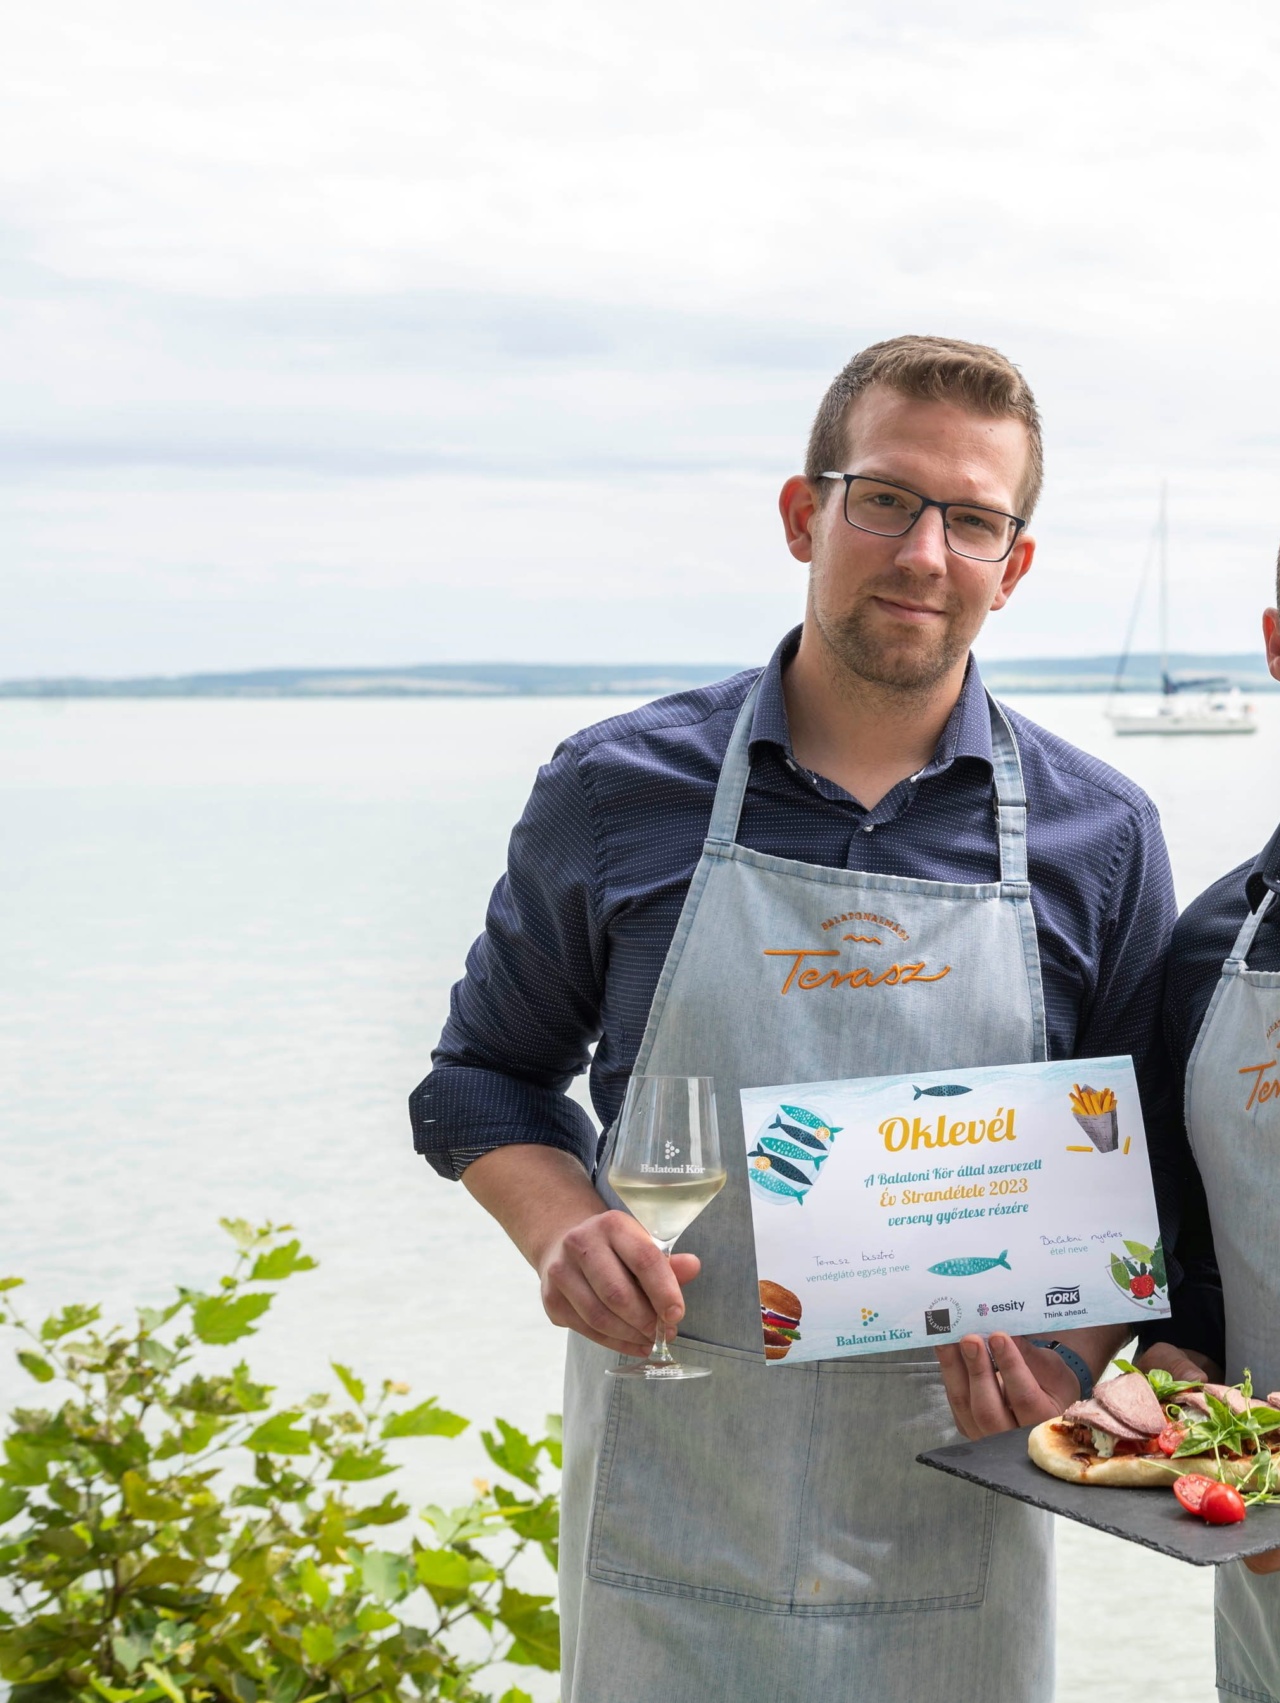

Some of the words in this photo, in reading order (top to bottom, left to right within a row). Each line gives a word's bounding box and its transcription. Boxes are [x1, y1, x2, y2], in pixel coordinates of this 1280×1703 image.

[763, 949, 951, 995] Terasz
[878, 1107, 1017, 1152] Oklevél
[640, 1163, 685, 1173] Balatoni
[685, 1164, 705, 1174] Kör
[864, 1174, 875, 1188] A
[877, 1170, 930, 1186] Balatoni
[932, 1167, 954, 1180] Kör
[957, 1164, 985, 1178] által
[987, 1159, 1042, 1175] szervezett
[880, 1187, 897, 1207] Év
[901, 1184, 986, 1205] Strandétele
[989, 1178, 1029, 1196] 2023
[888, 1213, 933, 1227] verseny
[936, 1207, 986, 1225] győztese
[988, 1201, 1029, 1216] részére
[1050, 1246, 1066, 1256] étel
[1068, 1245, 1088, 1254] neve
[806, 1269, 855, 1283] vendéglátó
[857, 1264, 888, 1278] egység
[889, 1264, 910, 1274] neve
[991, 1299, 1025, 1314] essity
[1046, 1292, 1078, 1306] TORK
[1065, 1308, 1088, 1318] ahead.
[836, 1330, 887, 1347] Balatoni
[889, 1328, 912, 1340] Kör
